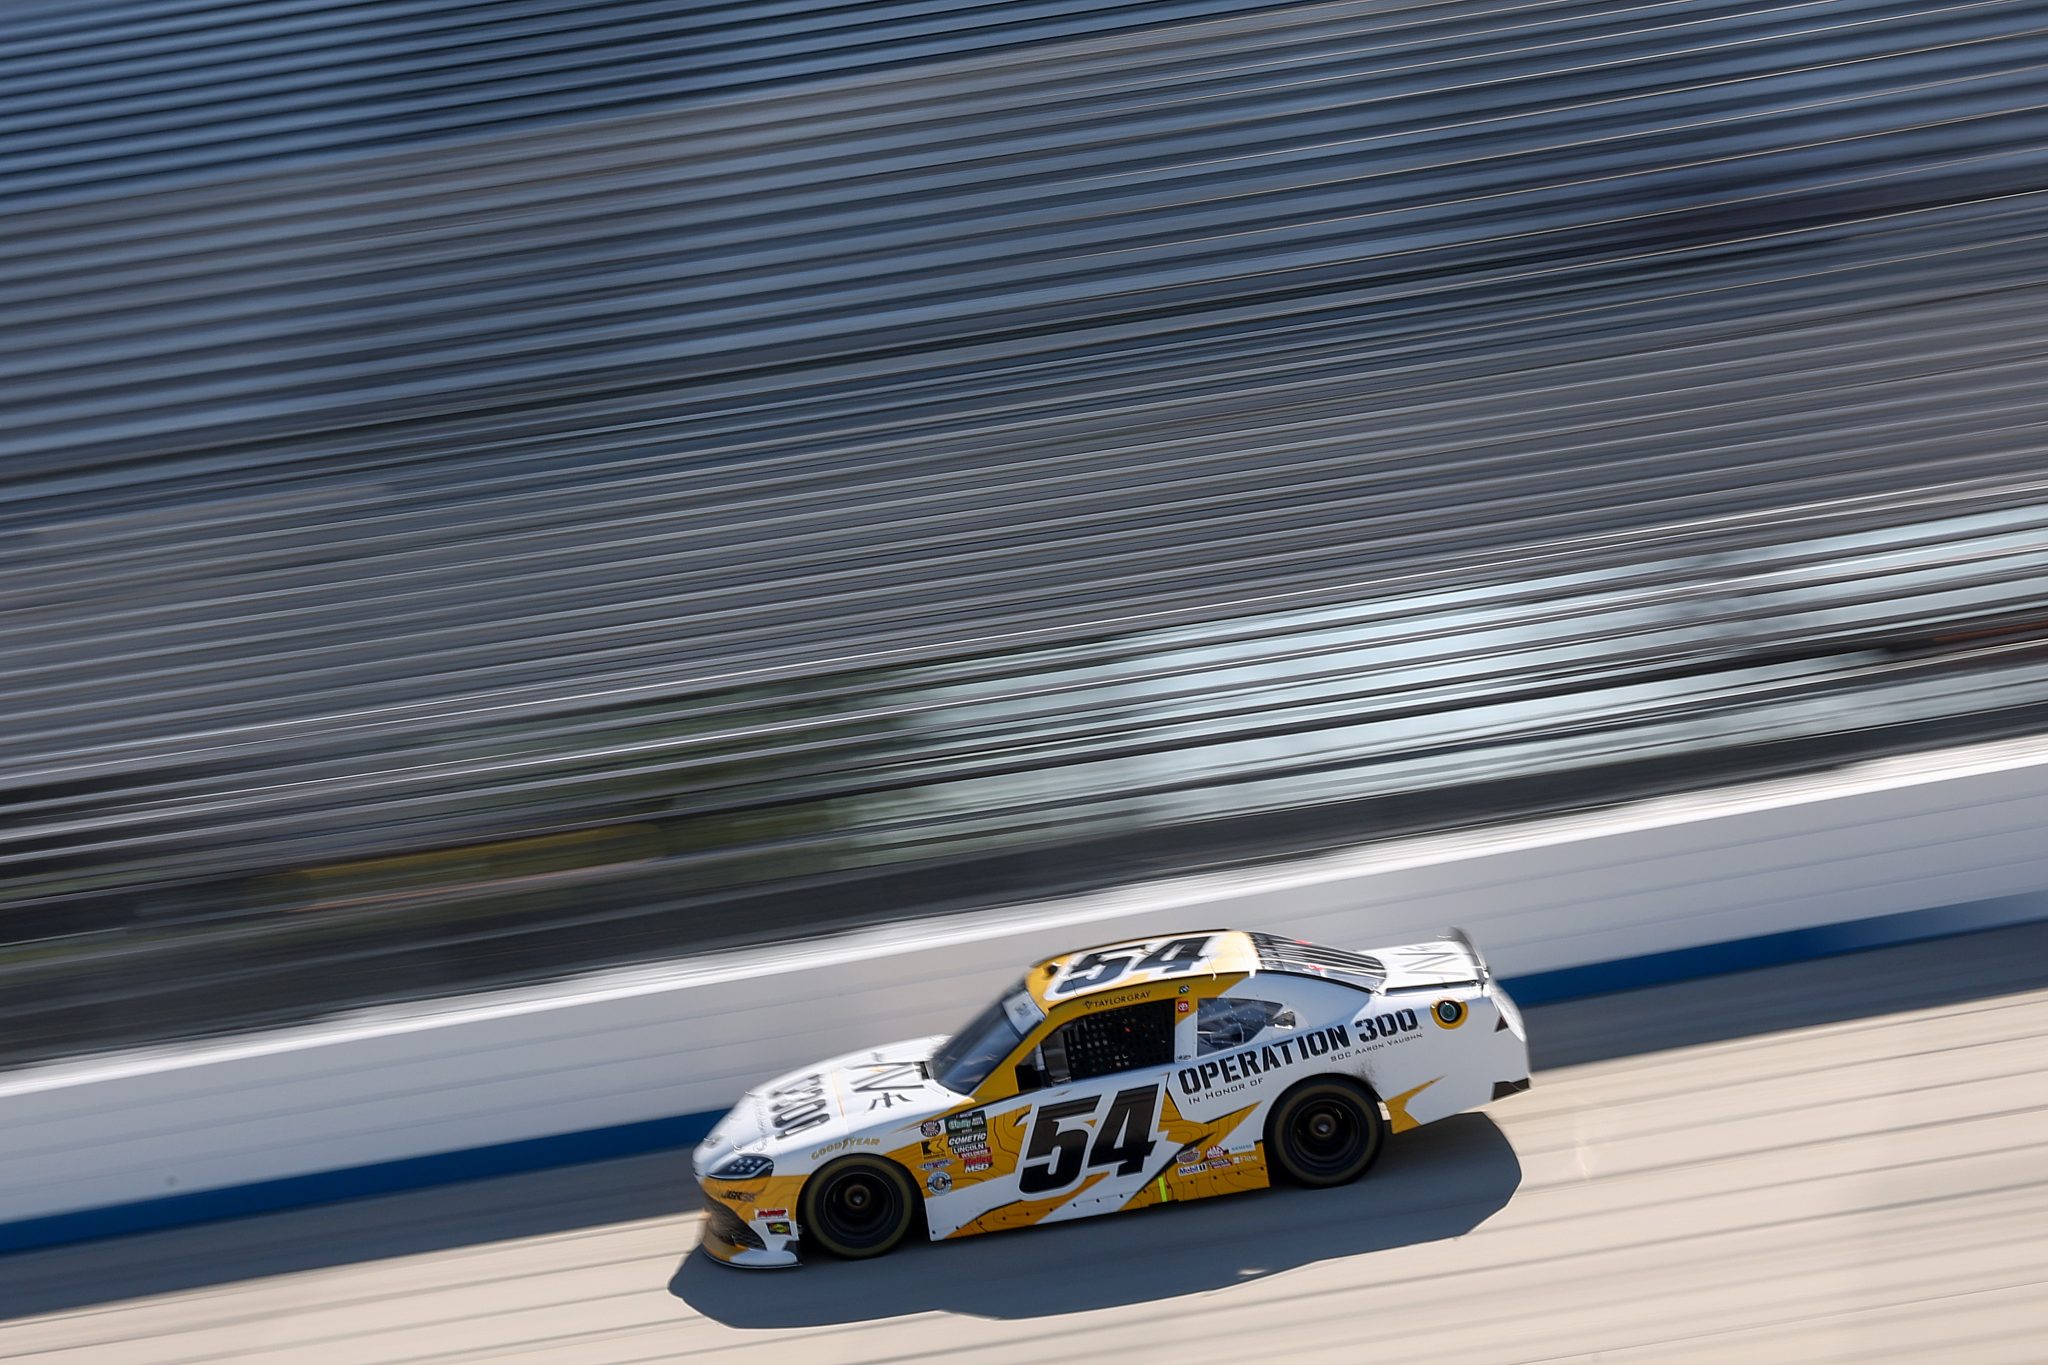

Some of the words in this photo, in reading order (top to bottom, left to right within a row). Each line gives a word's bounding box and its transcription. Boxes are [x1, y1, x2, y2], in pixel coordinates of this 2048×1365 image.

[1055, 936, 1213, 994] 54
[1093, 995, 1127, 1009] TAYLOR
[1127, 991, 1151, 1003] GRAY
[1178, 1024, 1351, 1095] OPERATION
[1354, 1008, 1419, 1043] 300
[811, 1137, 881, 1160] GOODYEAR
[948, 1132, 987, 1146] COMETIC
[953, 1142, 984, 1154] LINCOLN
[1019, 1084, 1159, 1194] 54
[964, 1163, 989, 1174] MSD
